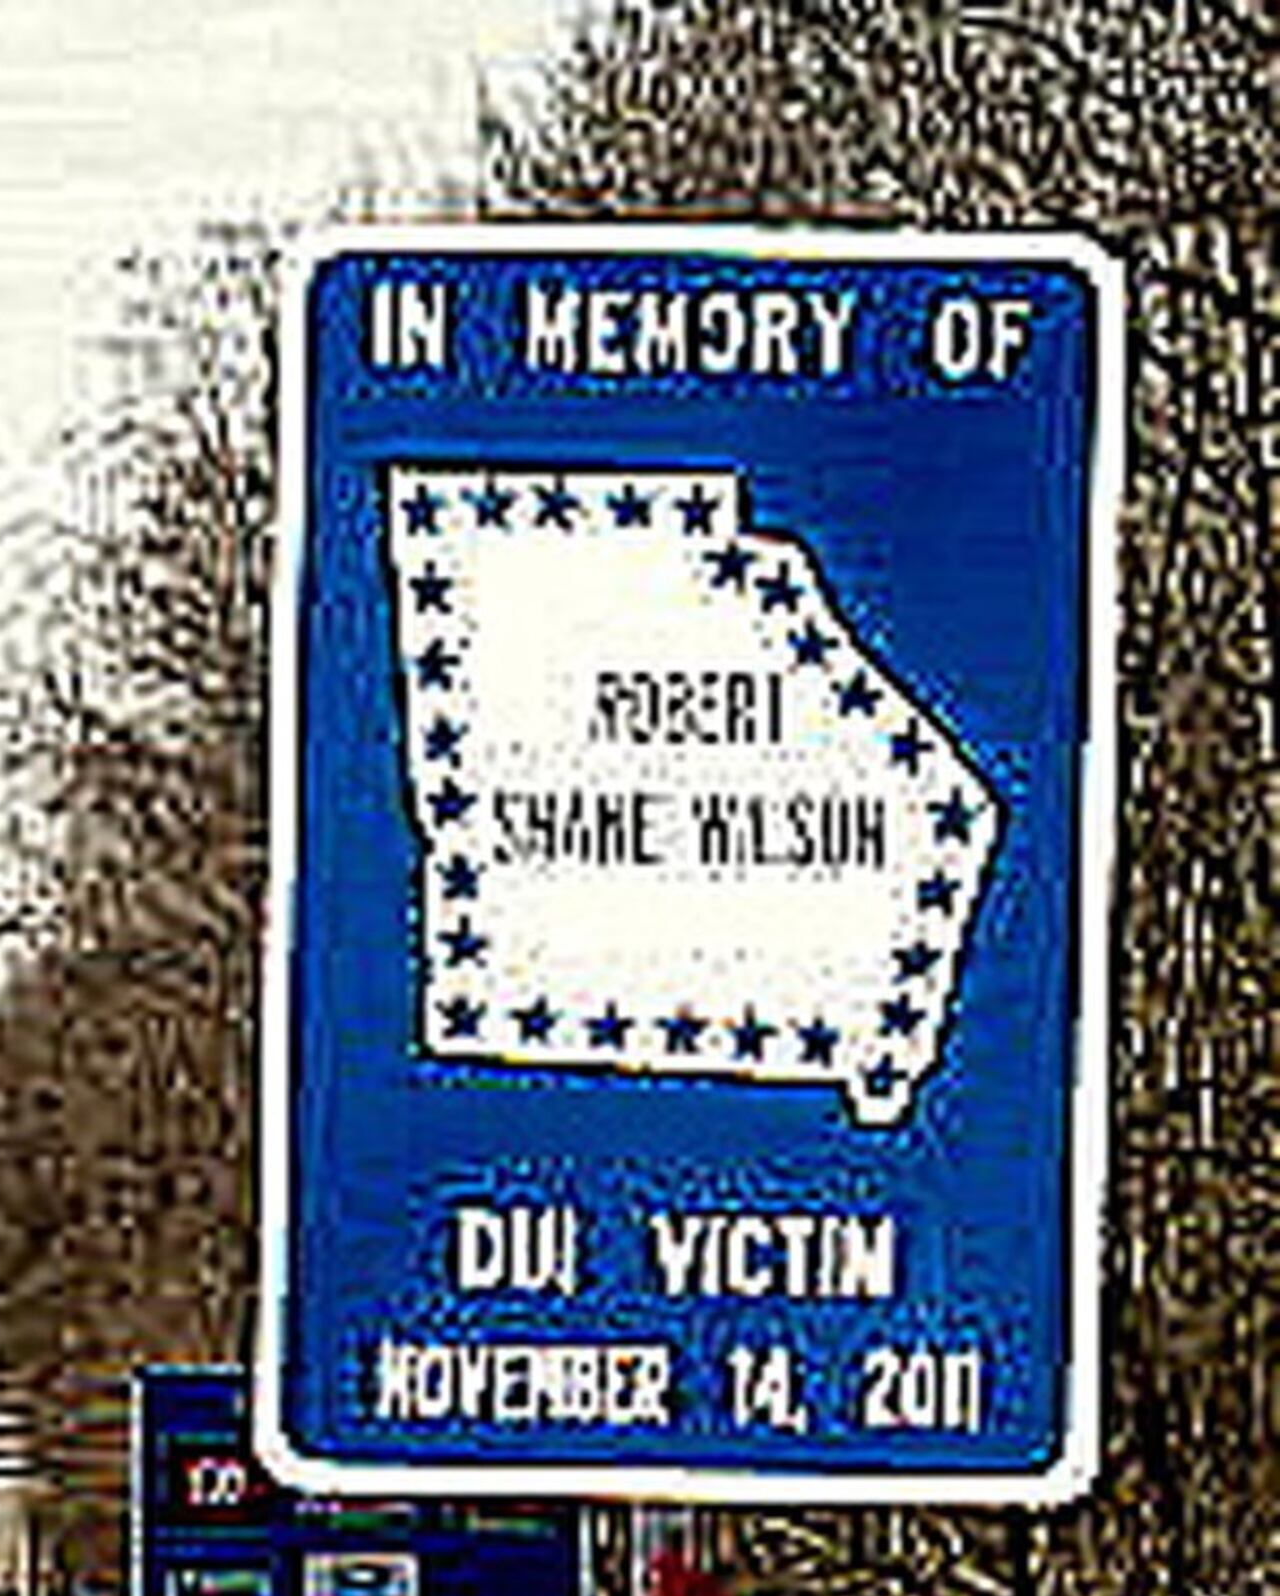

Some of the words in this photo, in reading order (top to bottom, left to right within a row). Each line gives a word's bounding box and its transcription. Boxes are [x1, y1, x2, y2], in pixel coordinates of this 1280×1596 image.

[370, 282, 446, 372] IN
[525, 284, 856, 376] MEMORY
[931, 298, 1032, 380] OF
[588, 671, 782, 744] ROBERT
[457, 1205, 577, 1296] DUI
[652, 1212, 897, 1298] VICTIM
[374, 1339, 671, 1423] NOVEMBER
[728, 1345, 809, 1434] 14,
[863, 1349, 981, 1432] 2011
